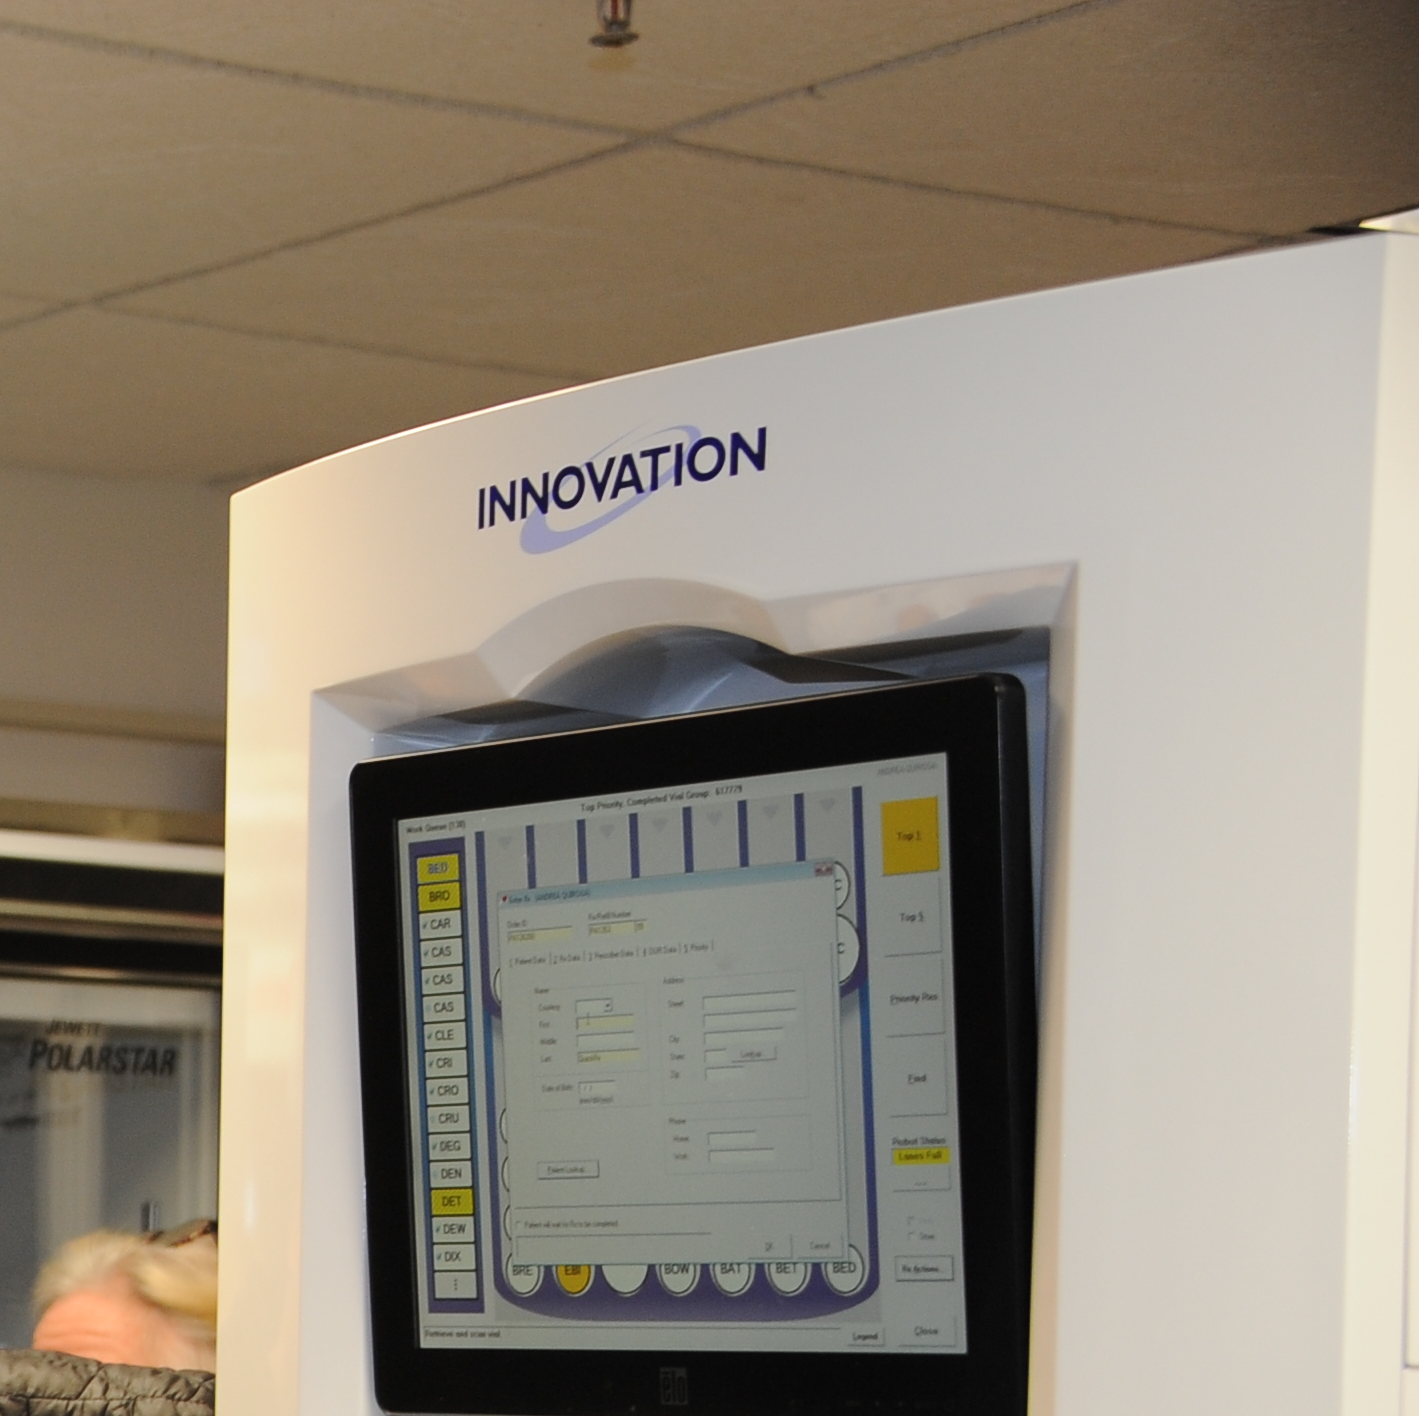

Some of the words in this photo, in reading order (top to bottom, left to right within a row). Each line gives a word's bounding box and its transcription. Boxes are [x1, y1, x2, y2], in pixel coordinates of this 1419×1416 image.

[477, 426, 767, 529] INNOVATION
[896, 831, 913, 842] Top
[430, 918, 451, 930] CAR
[900, 913, 916, 923] Top
[431, 946, 452, 958] CAS
[432, 973, 453, 985] CAS
[434, 1001, 454, 1013] CAS
[435, 1029, 454, 1041] CLE
[28, 1038, 176, 1076] POLARSTAR
[436, 1057, 452, 1069] CRI
[438, 1113, 459, 1124] CRU
[441, 1168, 462, 1179] DEN
[442, 1196, 462, 1207] DET
[443, 1223, 466, 1235] DEW
[720, 1263, 742, 1274] BAT
[775, 1263, 798, 1274] BET
[832, 1262, 857, 1274] BED
